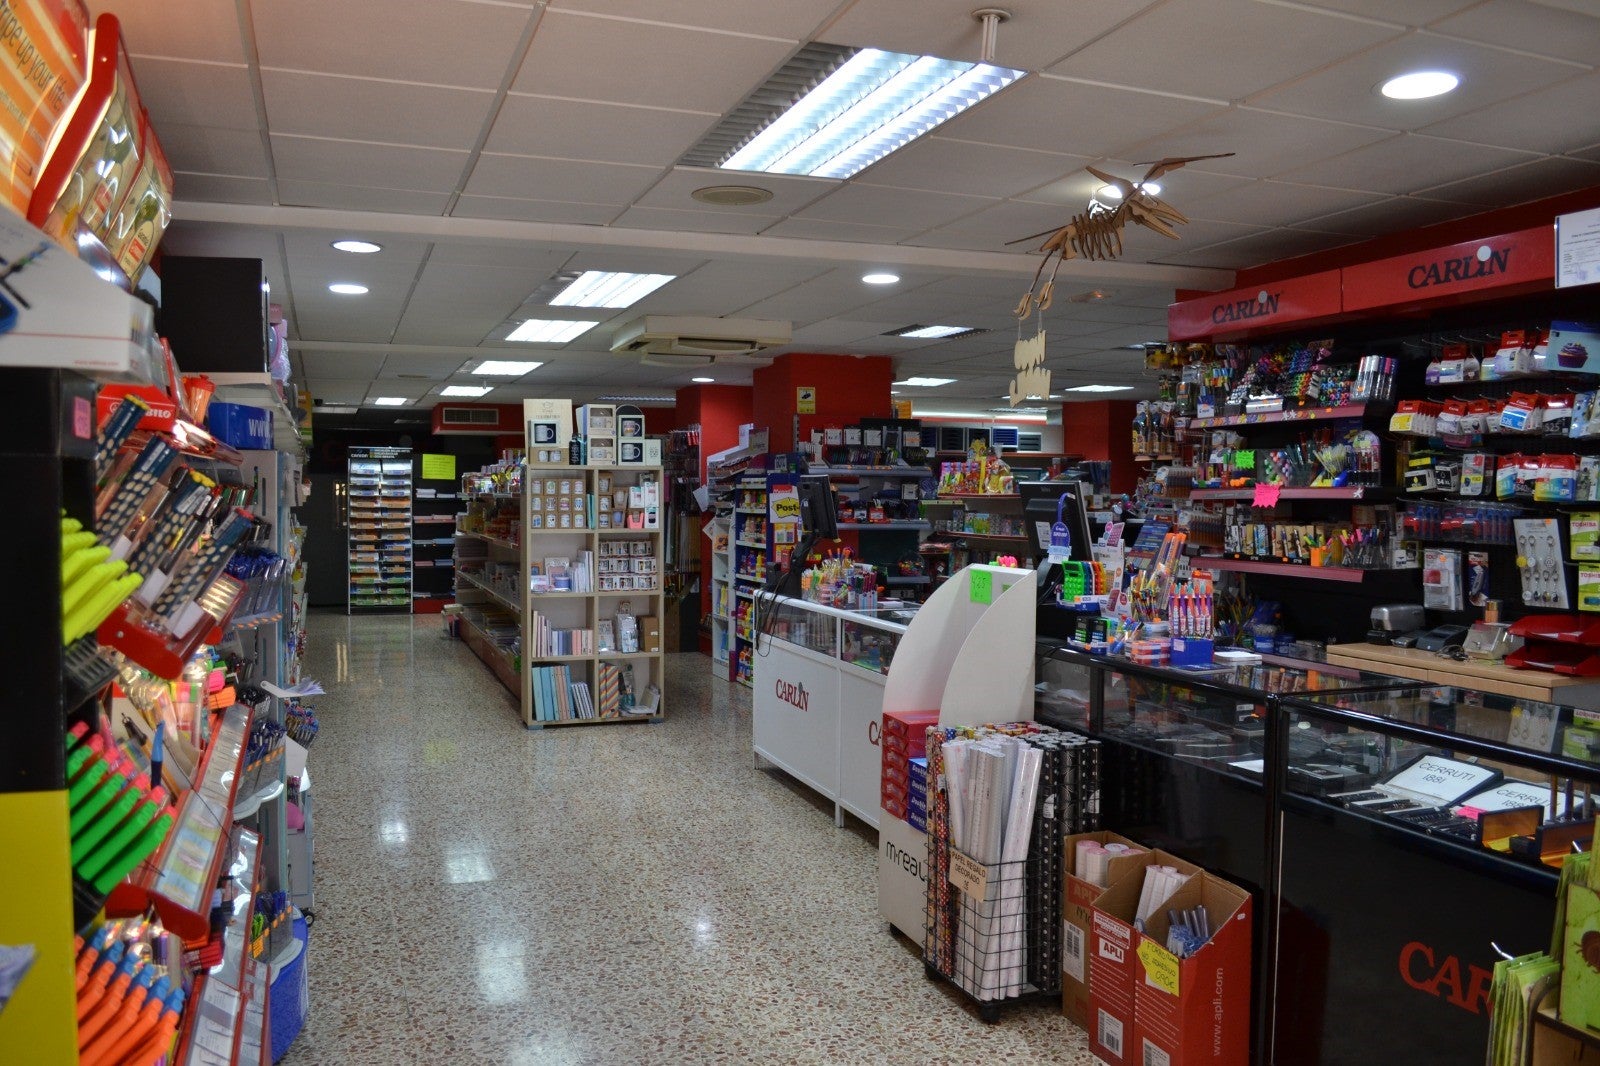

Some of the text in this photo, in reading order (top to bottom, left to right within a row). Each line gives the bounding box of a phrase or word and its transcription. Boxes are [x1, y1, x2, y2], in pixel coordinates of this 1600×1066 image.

[16, 36, 35, 69] up
[24, 55, 54, 92] your
[776, 678, 809, 712] CARLIN
[1418, 762, 1476, 781] CERRUTI
[1422, 774, 1446, 785] 1881
[1103, 942, 1123, 959] APLI
[1213, 967, 1224, 1057] www.apli.com
